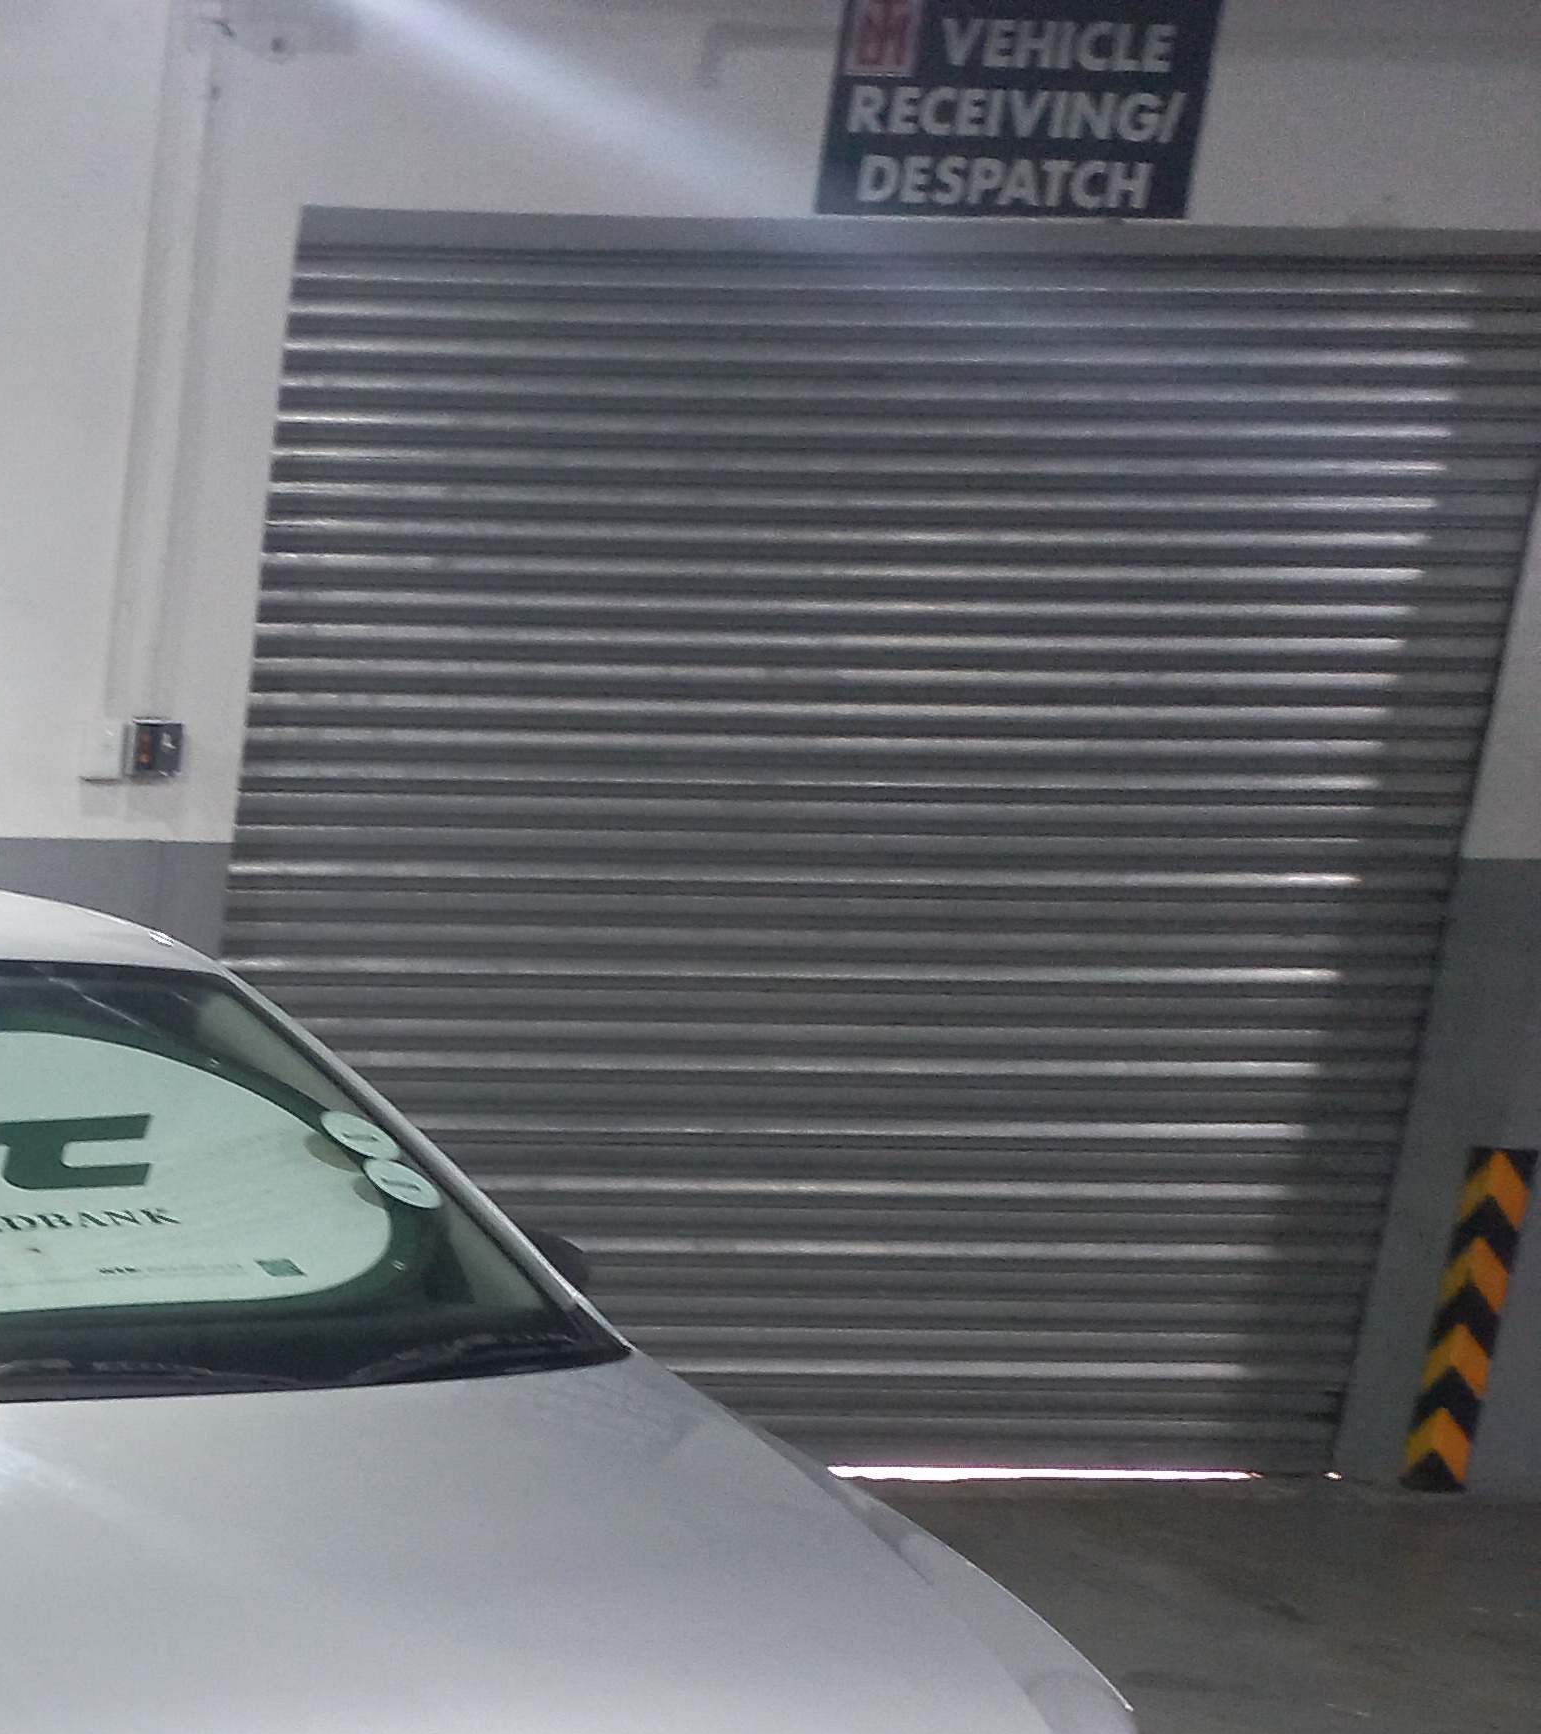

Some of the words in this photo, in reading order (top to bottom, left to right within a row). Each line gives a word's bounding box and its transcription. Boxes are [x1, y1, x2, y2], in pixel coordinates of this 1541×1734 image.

[941, 16, 1180, 73] VEHICLE
[846, 84, 1188, 144] RECEIVING/
[856, 153, 1156, 211] DESPATCH
